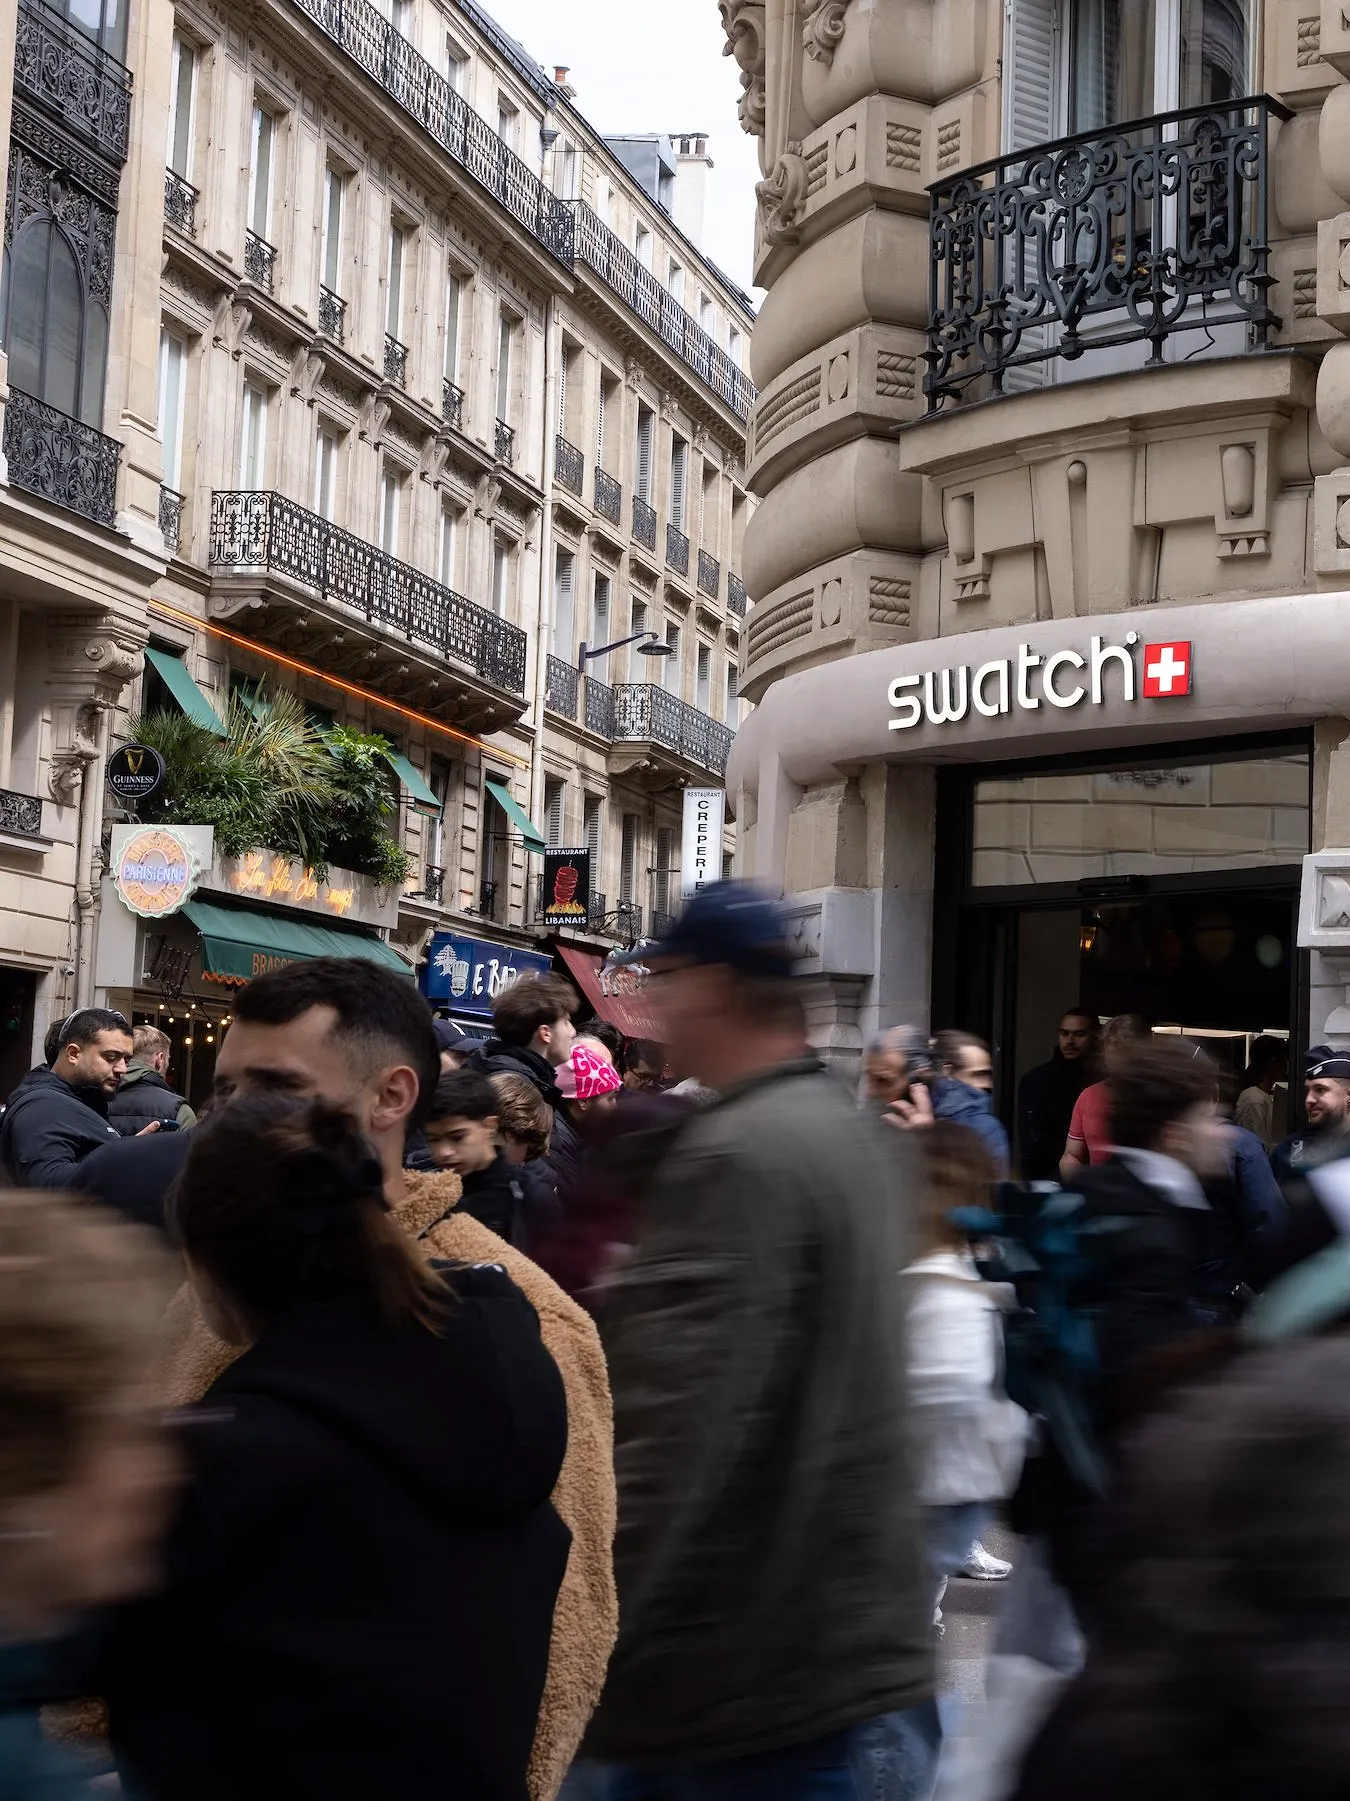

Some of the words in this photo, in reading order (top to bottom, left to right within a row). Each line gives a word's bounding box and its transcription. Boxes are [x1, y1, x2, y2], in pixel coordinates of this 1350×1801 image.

[113, 775, 154, 783] GUINNESS
[695, 800, 709, 890] CREPERIE
[545, 917, 587, 925] LIBANAIS
[471, 963, 485, 995] E
